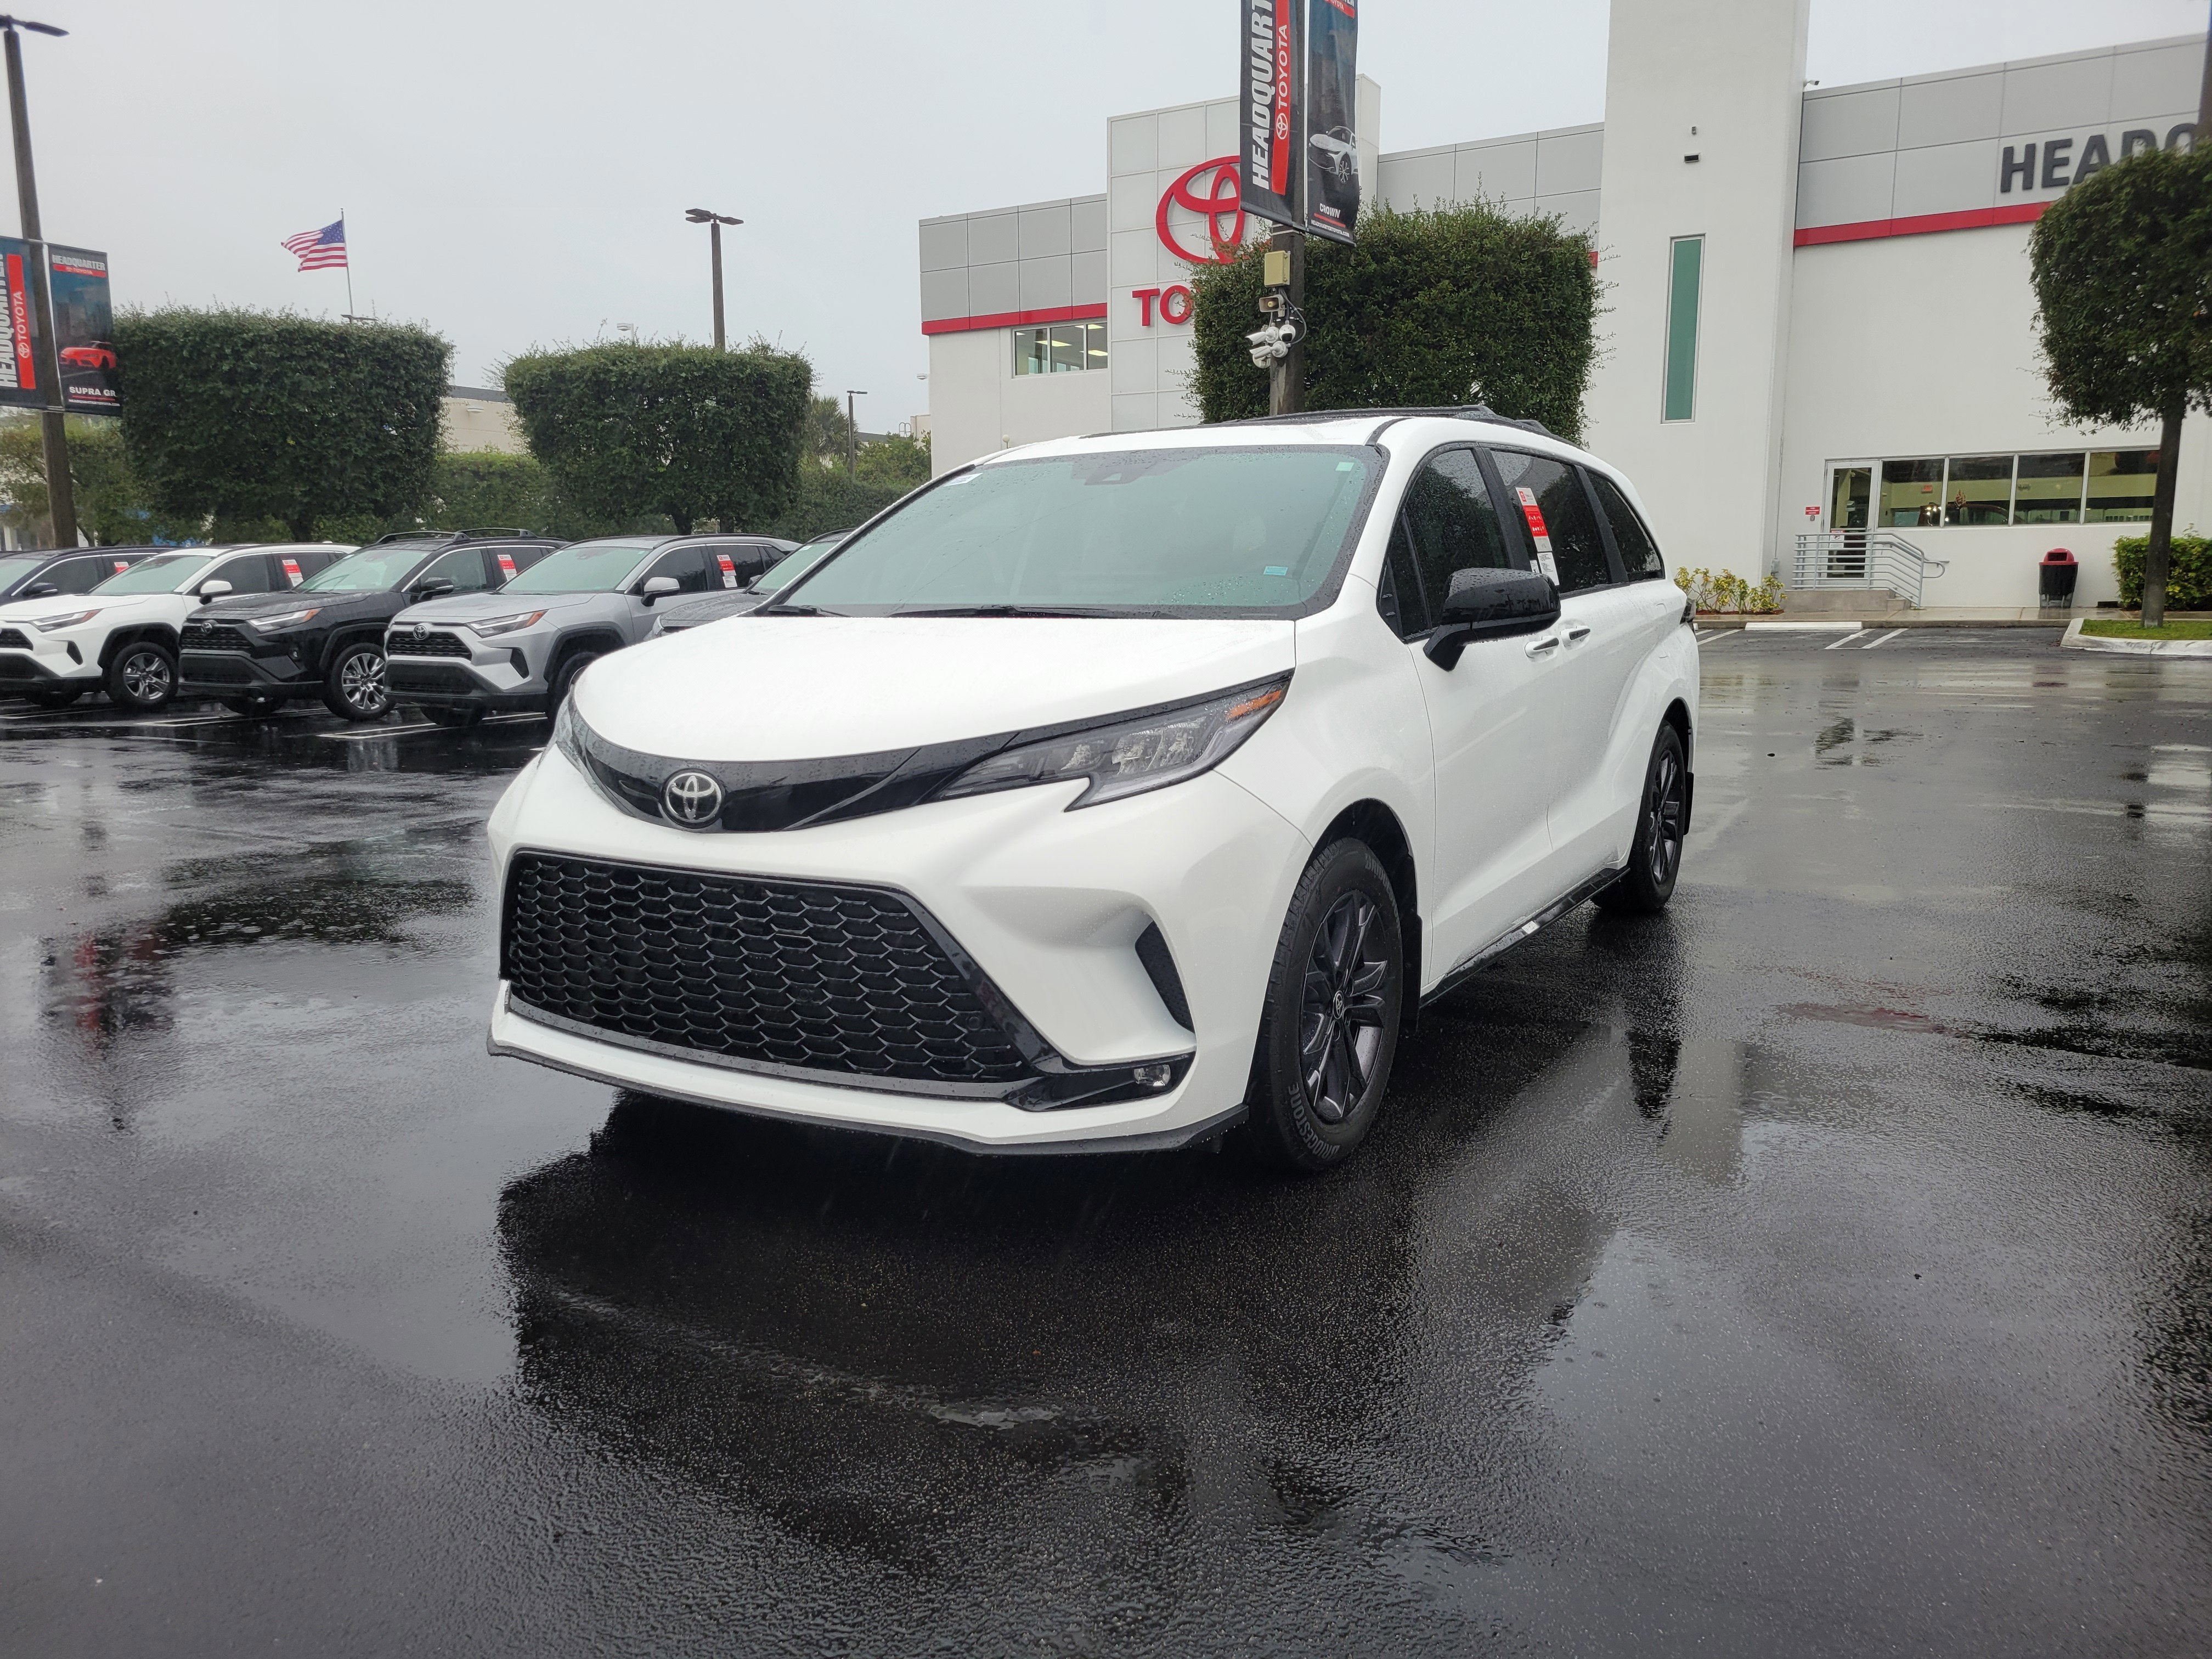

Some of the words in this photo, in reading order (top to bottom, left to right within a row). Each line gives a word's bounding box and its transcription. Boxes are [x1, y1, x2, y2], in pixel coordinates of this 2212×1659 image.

[1278, 25, 1288, 109] TOYOTA
[1319, 202, 1341, 219] CROWN
[52, 254, 106, 271] HEADQUARTER
[13, 291, 27, 341] TOYOTA
[69, 386, 102, 396] SUPRA
[103, 389, 117, 397] GR
